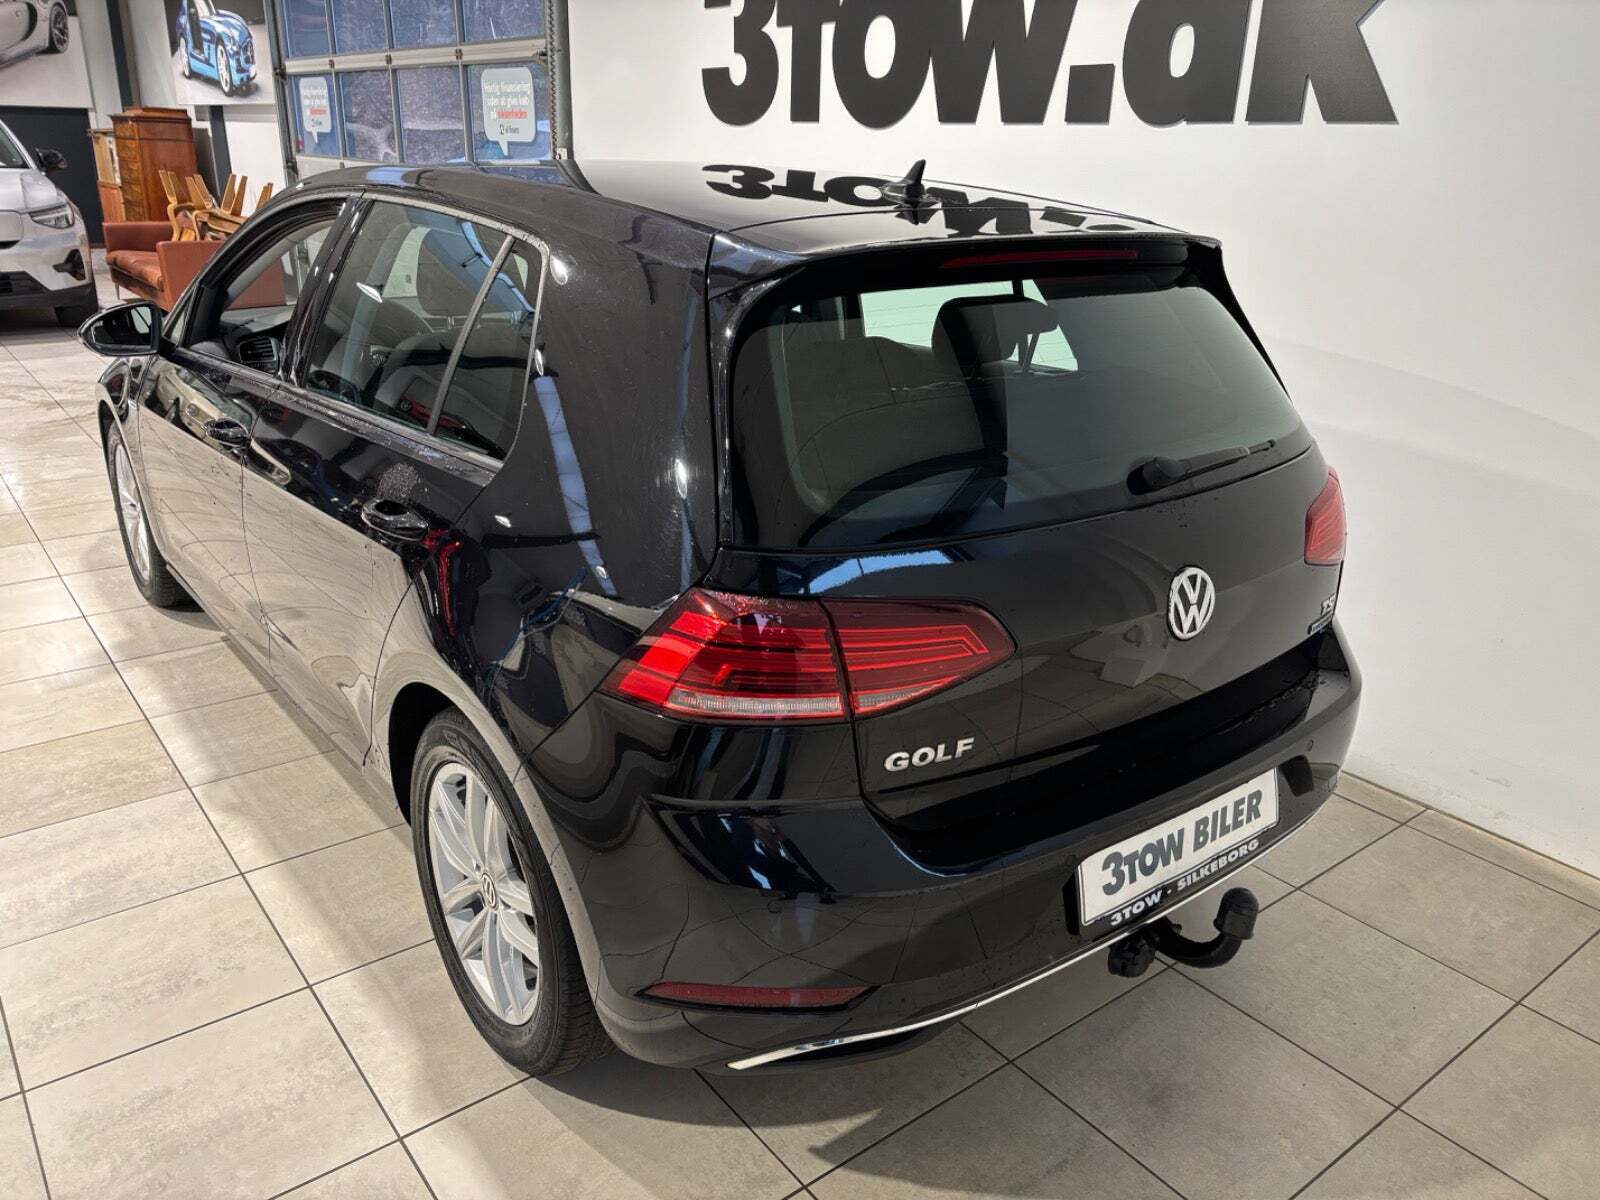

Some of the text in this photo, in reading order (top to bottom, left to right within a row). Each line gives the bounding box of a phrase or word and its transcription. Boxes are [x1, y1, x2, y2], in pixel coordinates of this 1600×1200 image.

[1168, 566, 1215, 640] VW
[883, 737, 975, 772] GOLF
[1101, 789, 1263, 896] 3TOW BILER
[1110, 838, 1260, 926] 3TOW SILKEBORG
